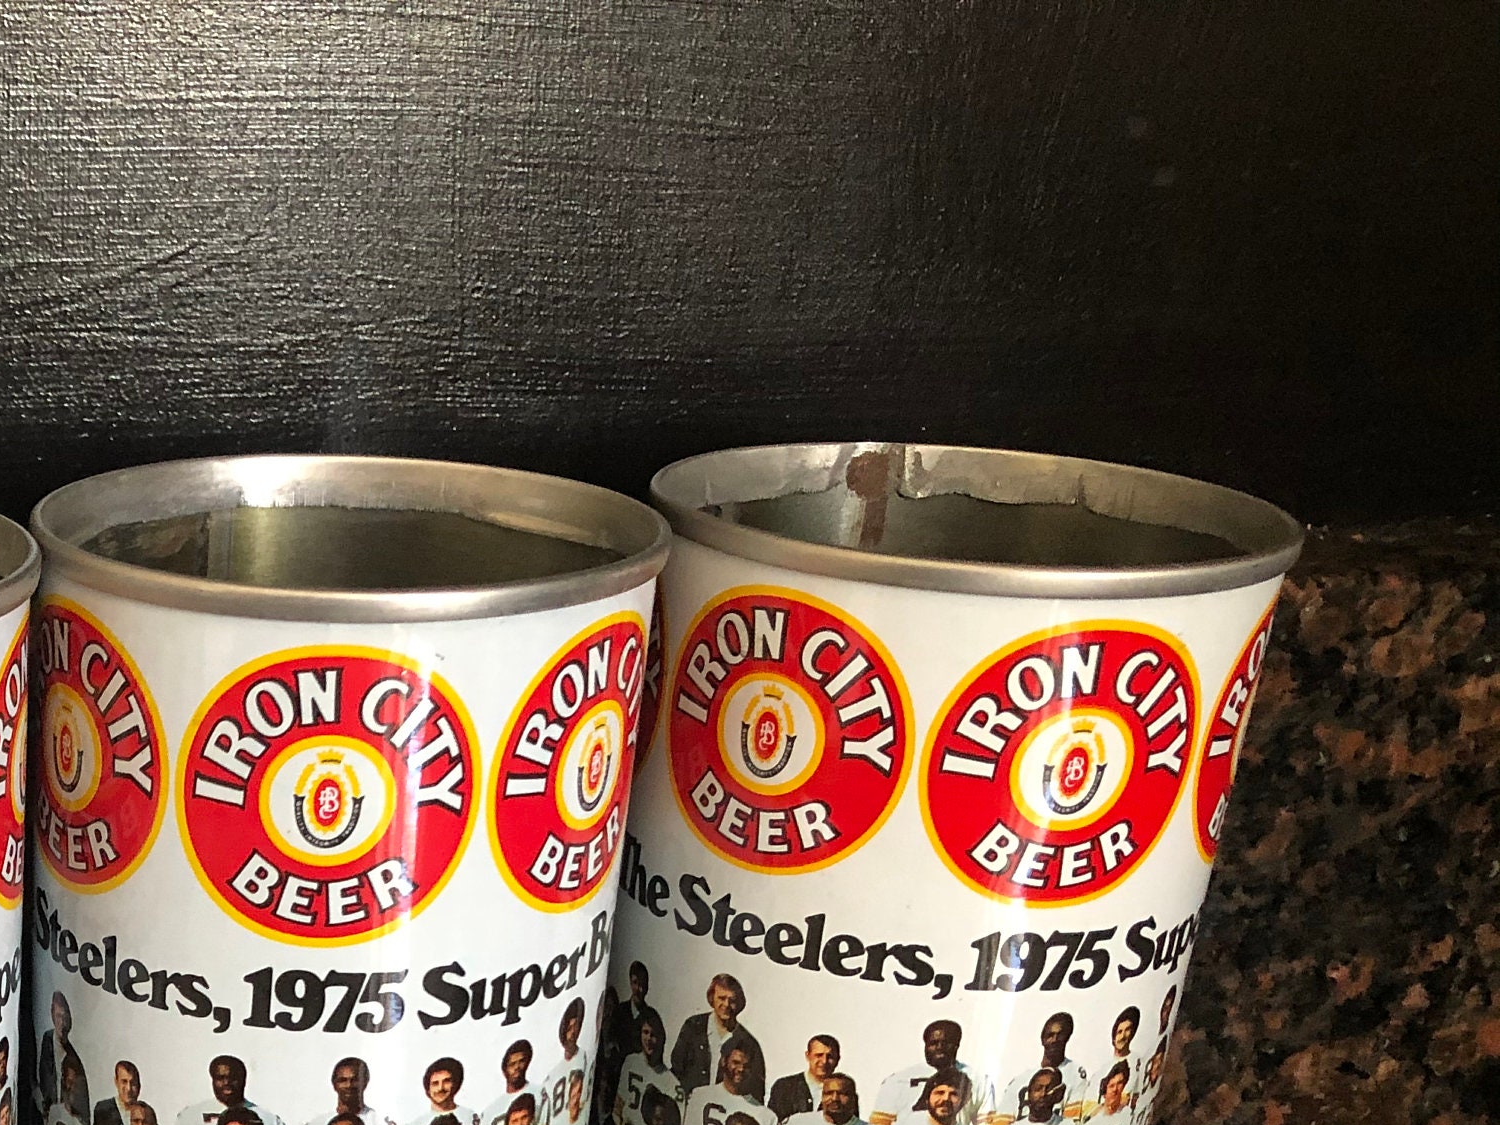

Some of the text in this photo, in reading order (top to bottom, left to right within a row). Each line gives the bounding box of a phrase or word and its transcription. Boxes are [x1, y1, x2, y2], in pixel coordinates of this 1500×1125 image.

[79, 640, 153, 800] CITY
[192, 666, 463, 817] IRON CITY
[504, 638, 610, 799] IRON
[677, 606, 789, 726] IRON
[800, 626, 896, 779] CITY
[939, 641, 1105, 782] IRON
[1114, 649, 1188, 779] CITY
[1208, 614, 1274, 761] IRO
[529, 804, 620, 890] BEER
[689, 766, 843, 855] BEER
[967, 818, 1139, 889] BEER
[227, 848, 419, 926] BEER
[673, 873, 953, 1001] Steelers,
[964, 925, 1118, 993] 1975
[1118, 915, 1200, 983] Sup
[35, 886, 231, 1034] Steelers,
[242, 967, 409, 1034] 1975
[417, 940, 587, 1031] Super
